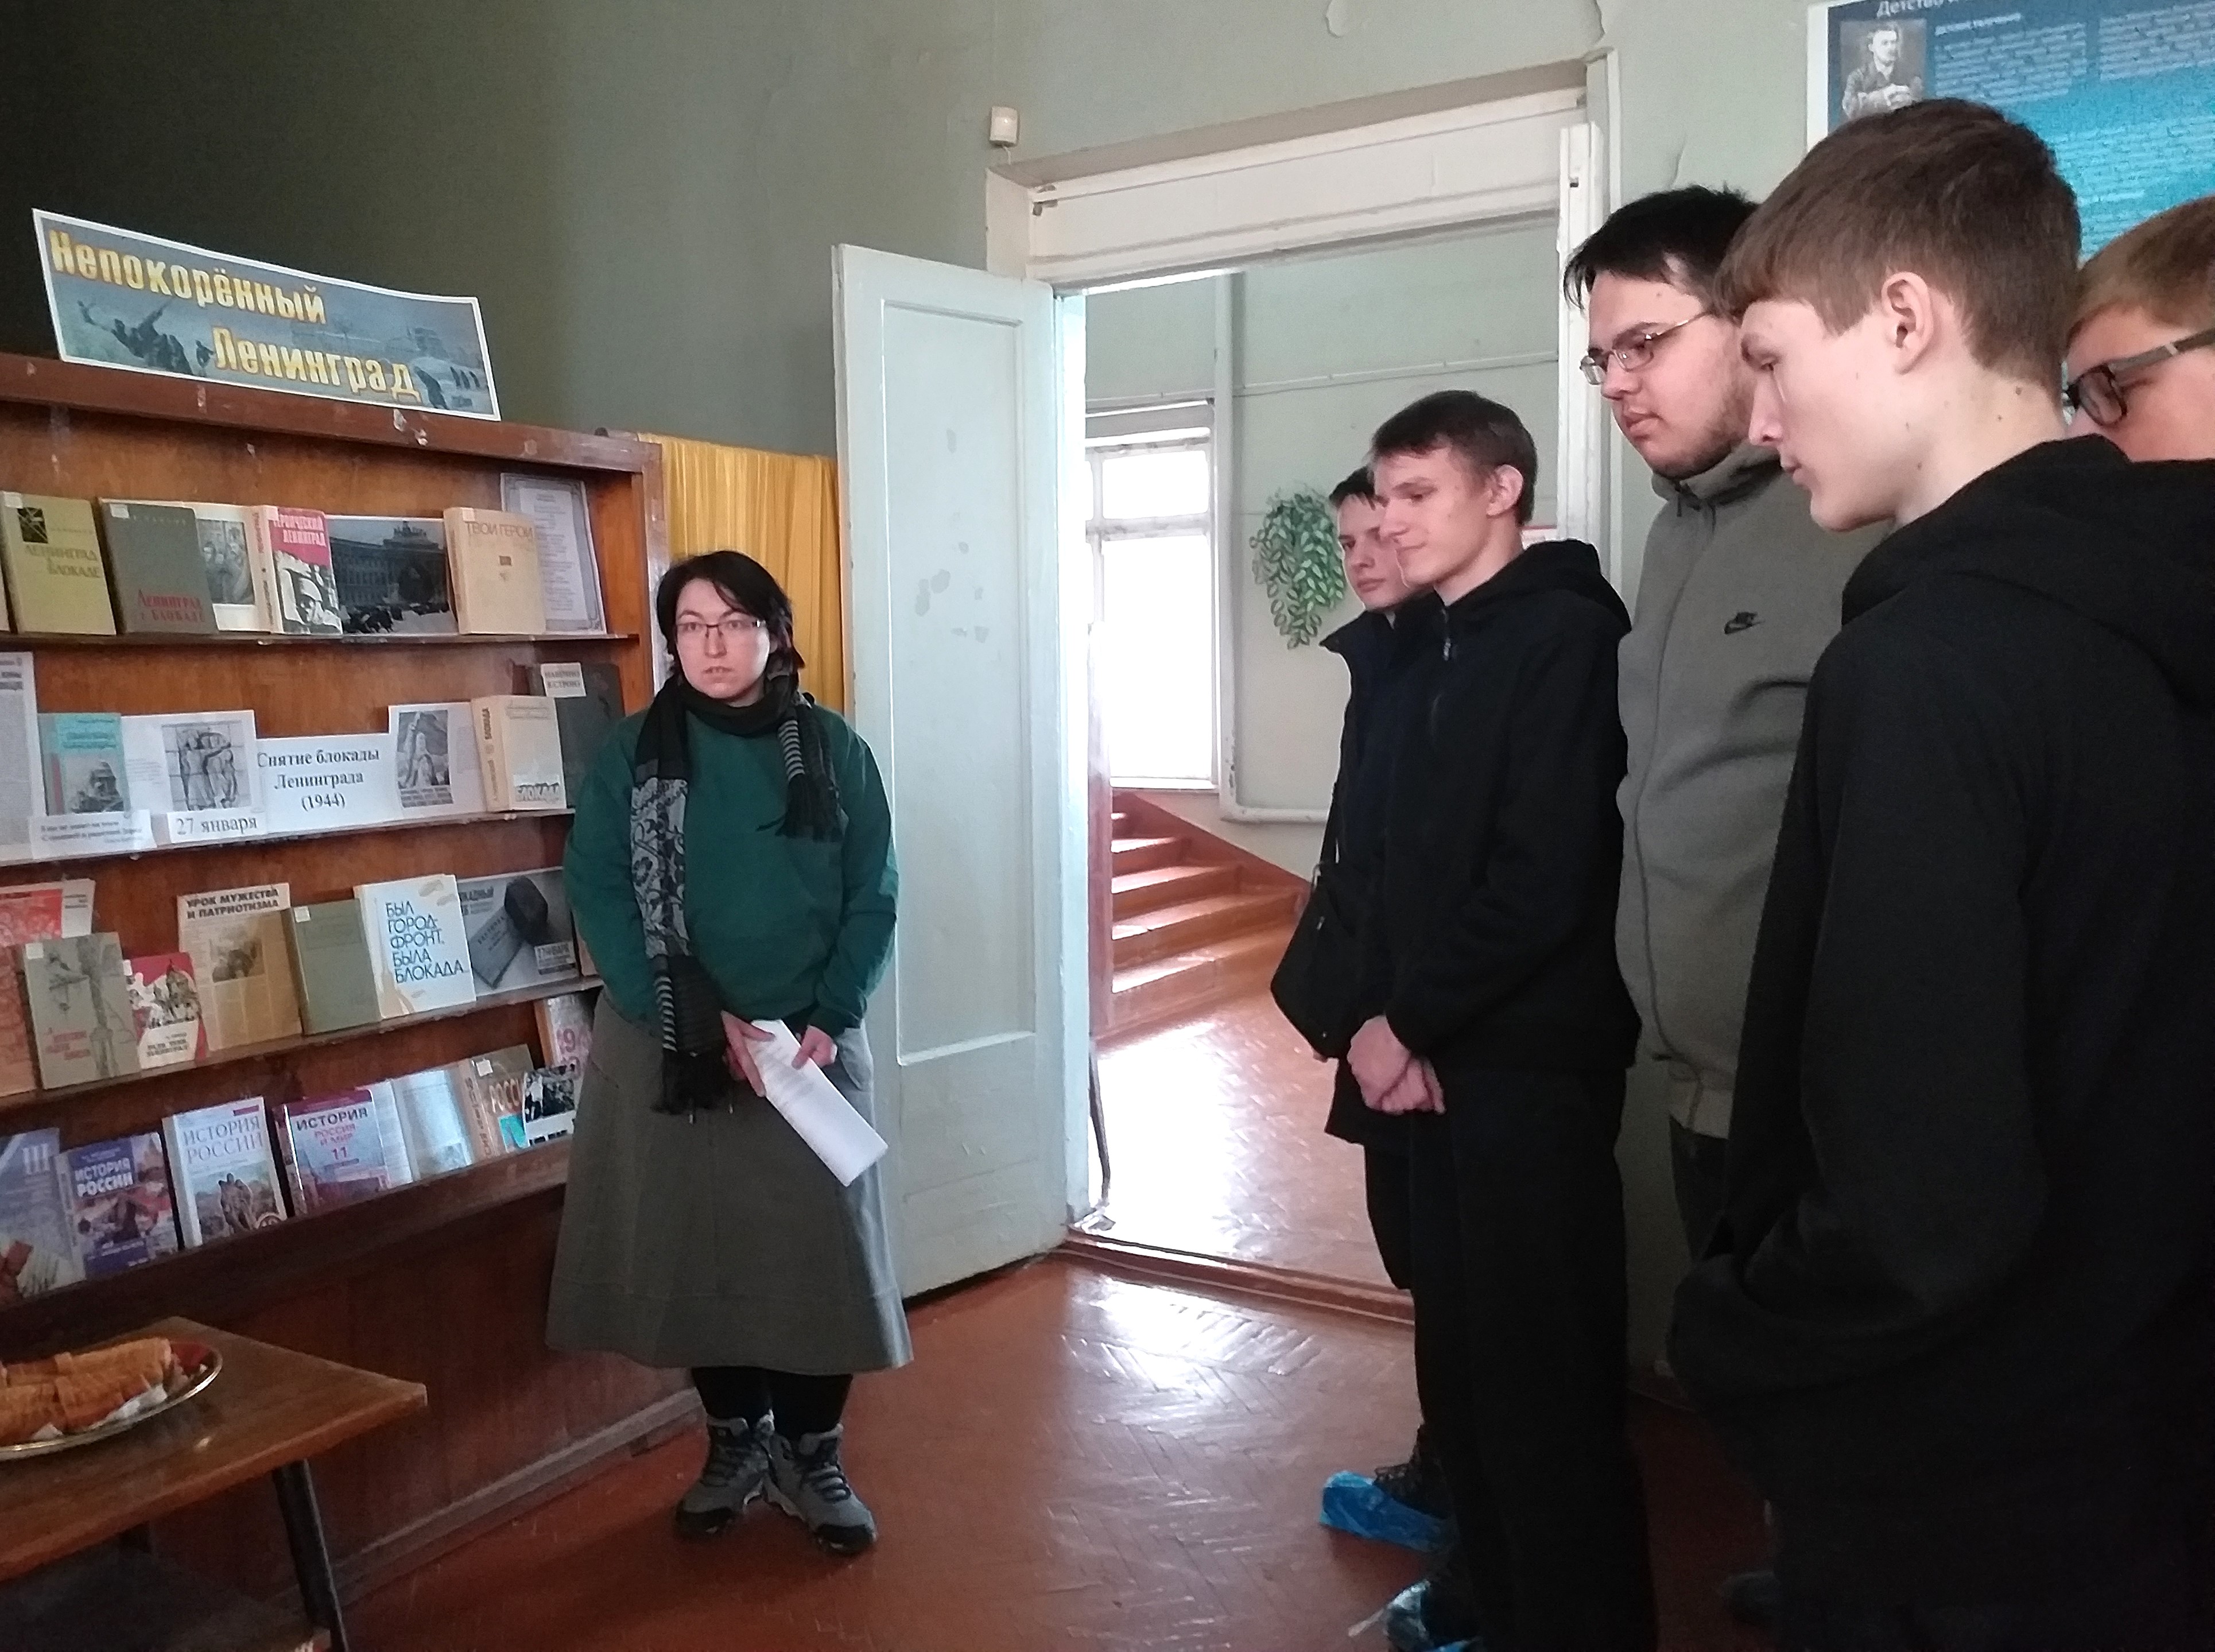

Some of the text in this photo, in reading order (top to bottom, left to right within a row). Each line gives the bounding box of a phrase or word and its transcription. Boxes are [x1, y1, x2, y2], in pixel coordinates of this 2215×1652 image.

[49, 230, 326, 324] Непокорённый
[212, 327, 422, 403] Ленинград
[257, 749, 380, 768] Снятие блокады
[274, 772, 364, 790] Ленинграда
[301, 792, 346, 812] (1944)
[176, 816, 258, 836] 27 января
[187, 889, 279, 908] УРОК МУЖЕСТВА
[199, 900, 279, 917] ПАТРИОТИЗМА
[386, 901, 415, 918] БЫЛ
[392, 948, 432, 967] БЫЛА
[296, 1107, 368, 1131] ИСТОРИЯ
[183, 1115, 260, 1146] ИСТОРИЯ
[187, 1132, 263, 1164] РОССИИ
[331, 1147, 347, 1160] 11
[75, 1157, 131, 1182] ИСТОРИЯ
[76, 1172, 134, 1197] РОССИИ
